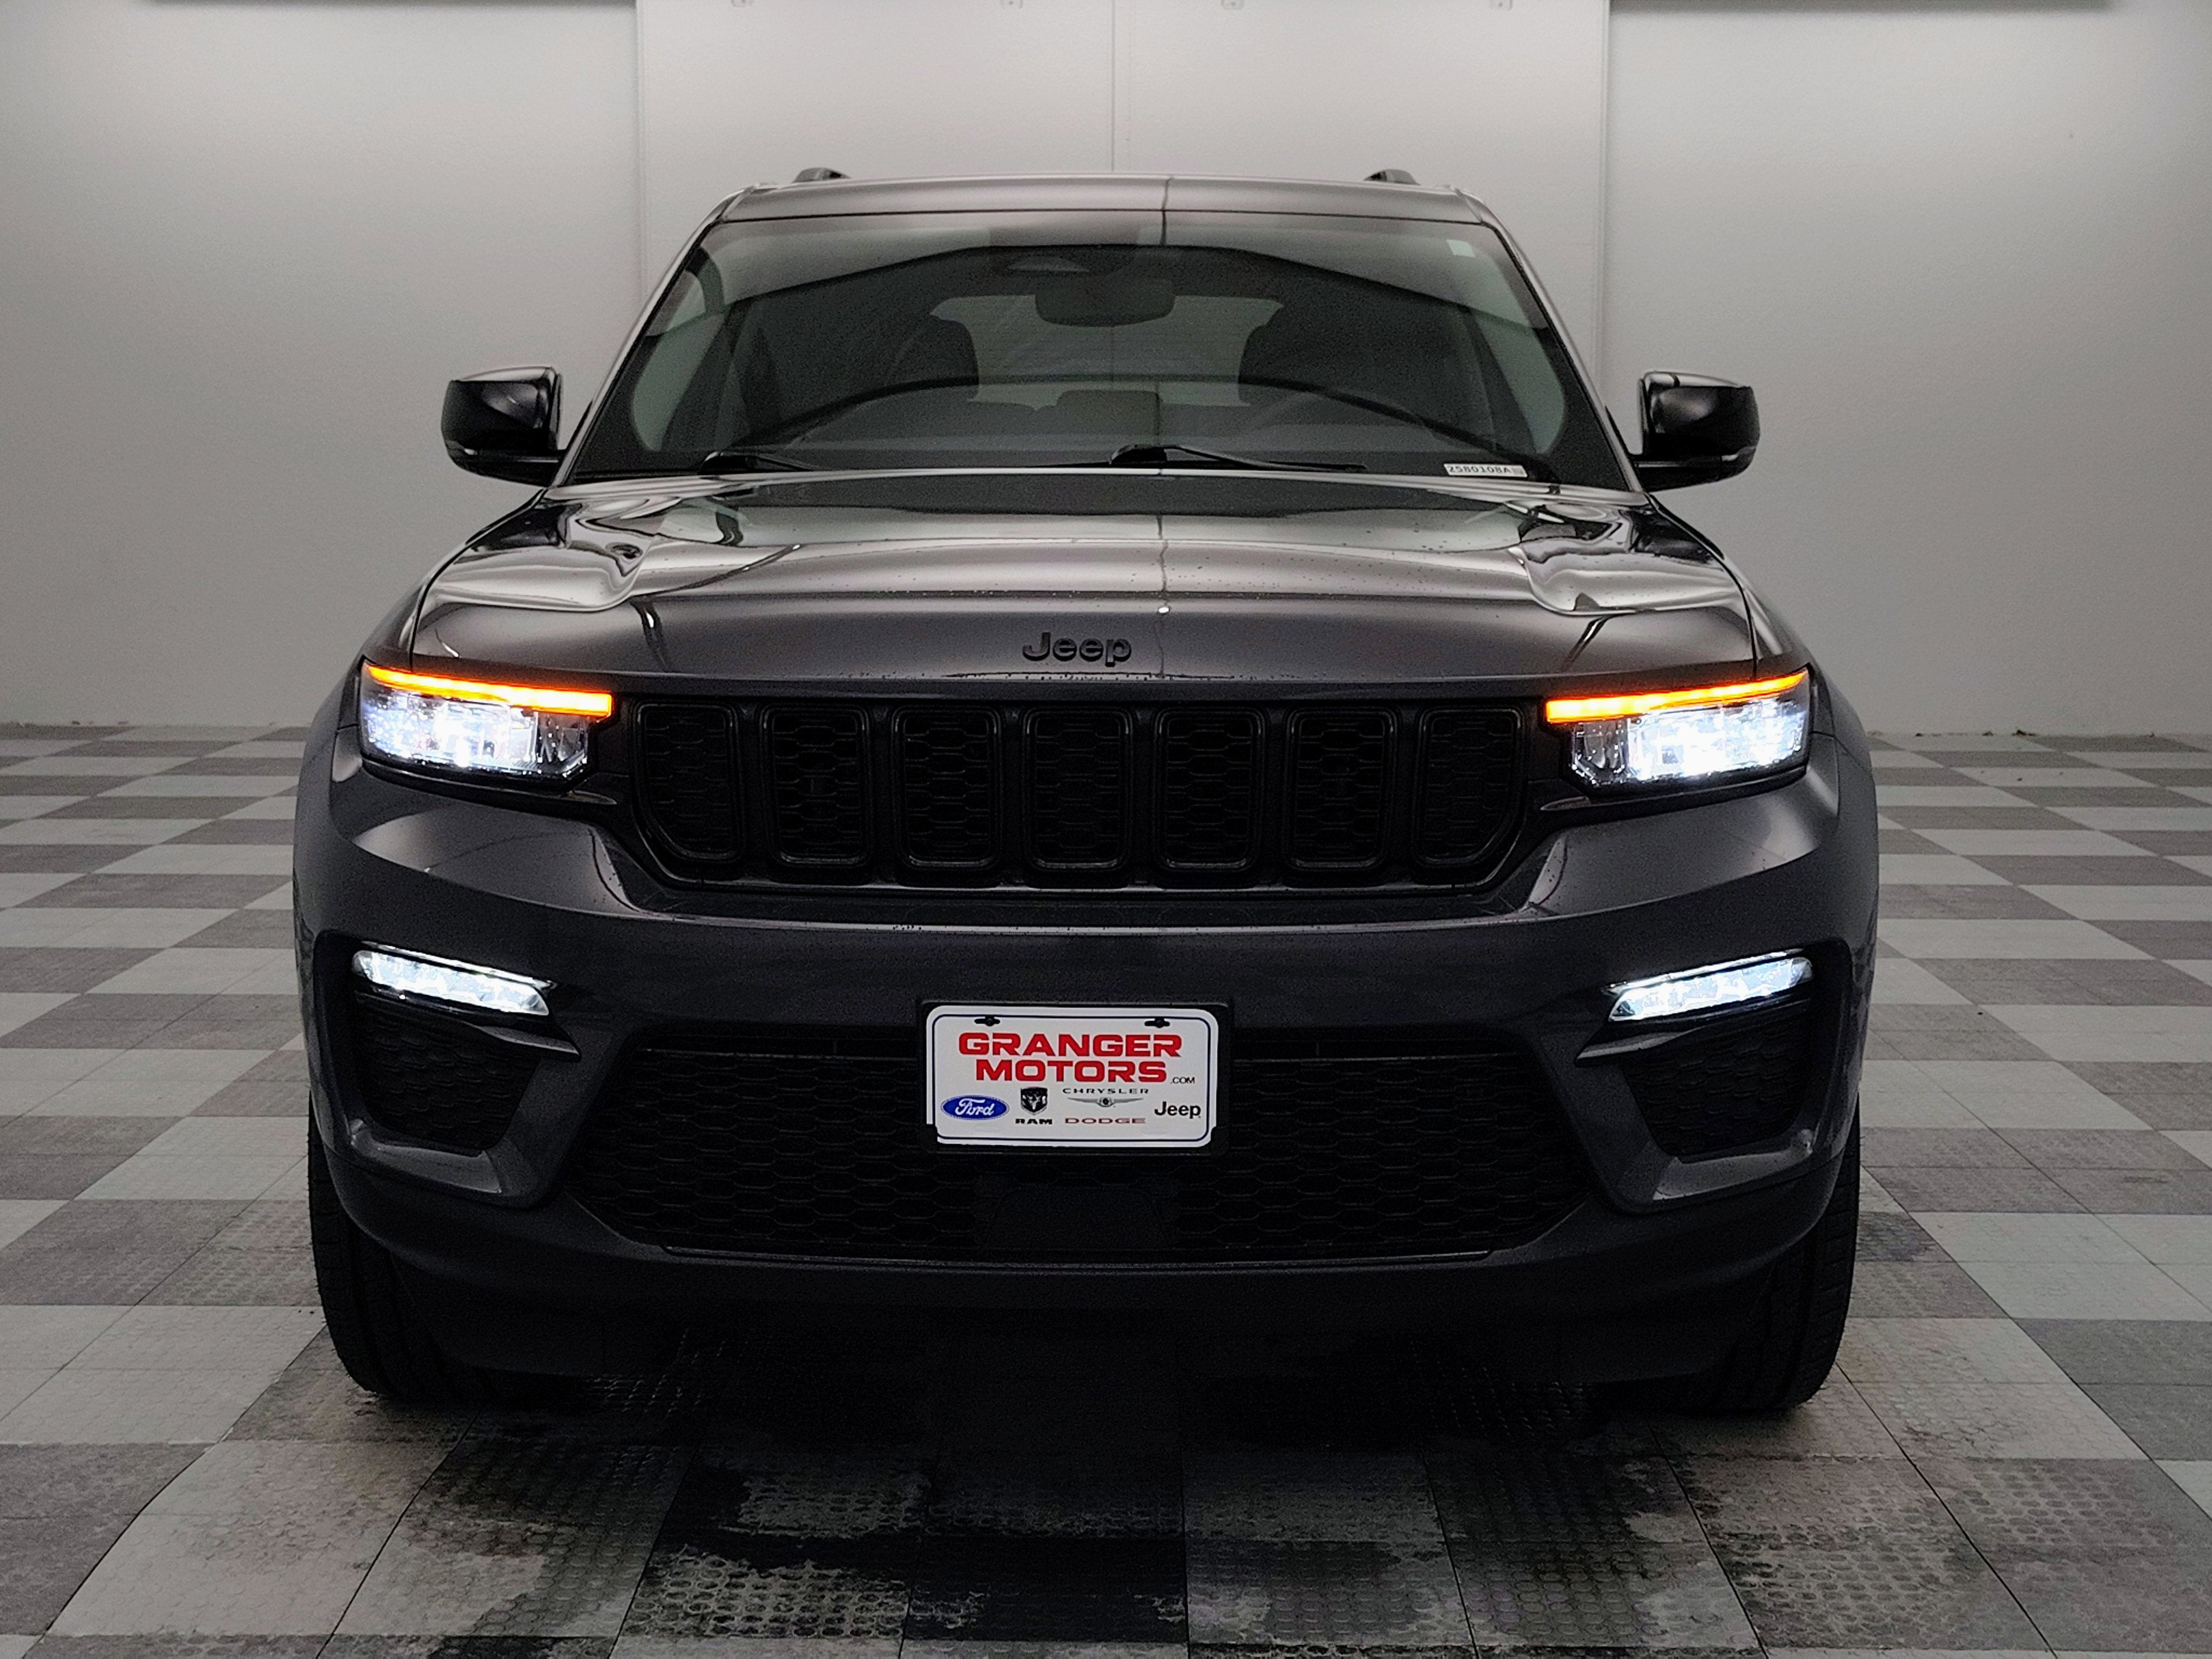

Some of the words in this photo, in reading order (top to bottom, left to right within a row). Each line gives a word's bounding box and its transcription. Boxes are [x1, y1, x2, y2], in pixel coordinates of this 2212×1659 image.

[1022, 632, 1132, 667] Jeep
[959, 1032, 1182, 1057] GRANGER
[976, 1059, 1166, 1082] MOTORS
[954, 1097, 995, 1117] Ford
[1154, 1101, 1201, 1119] Jeep
